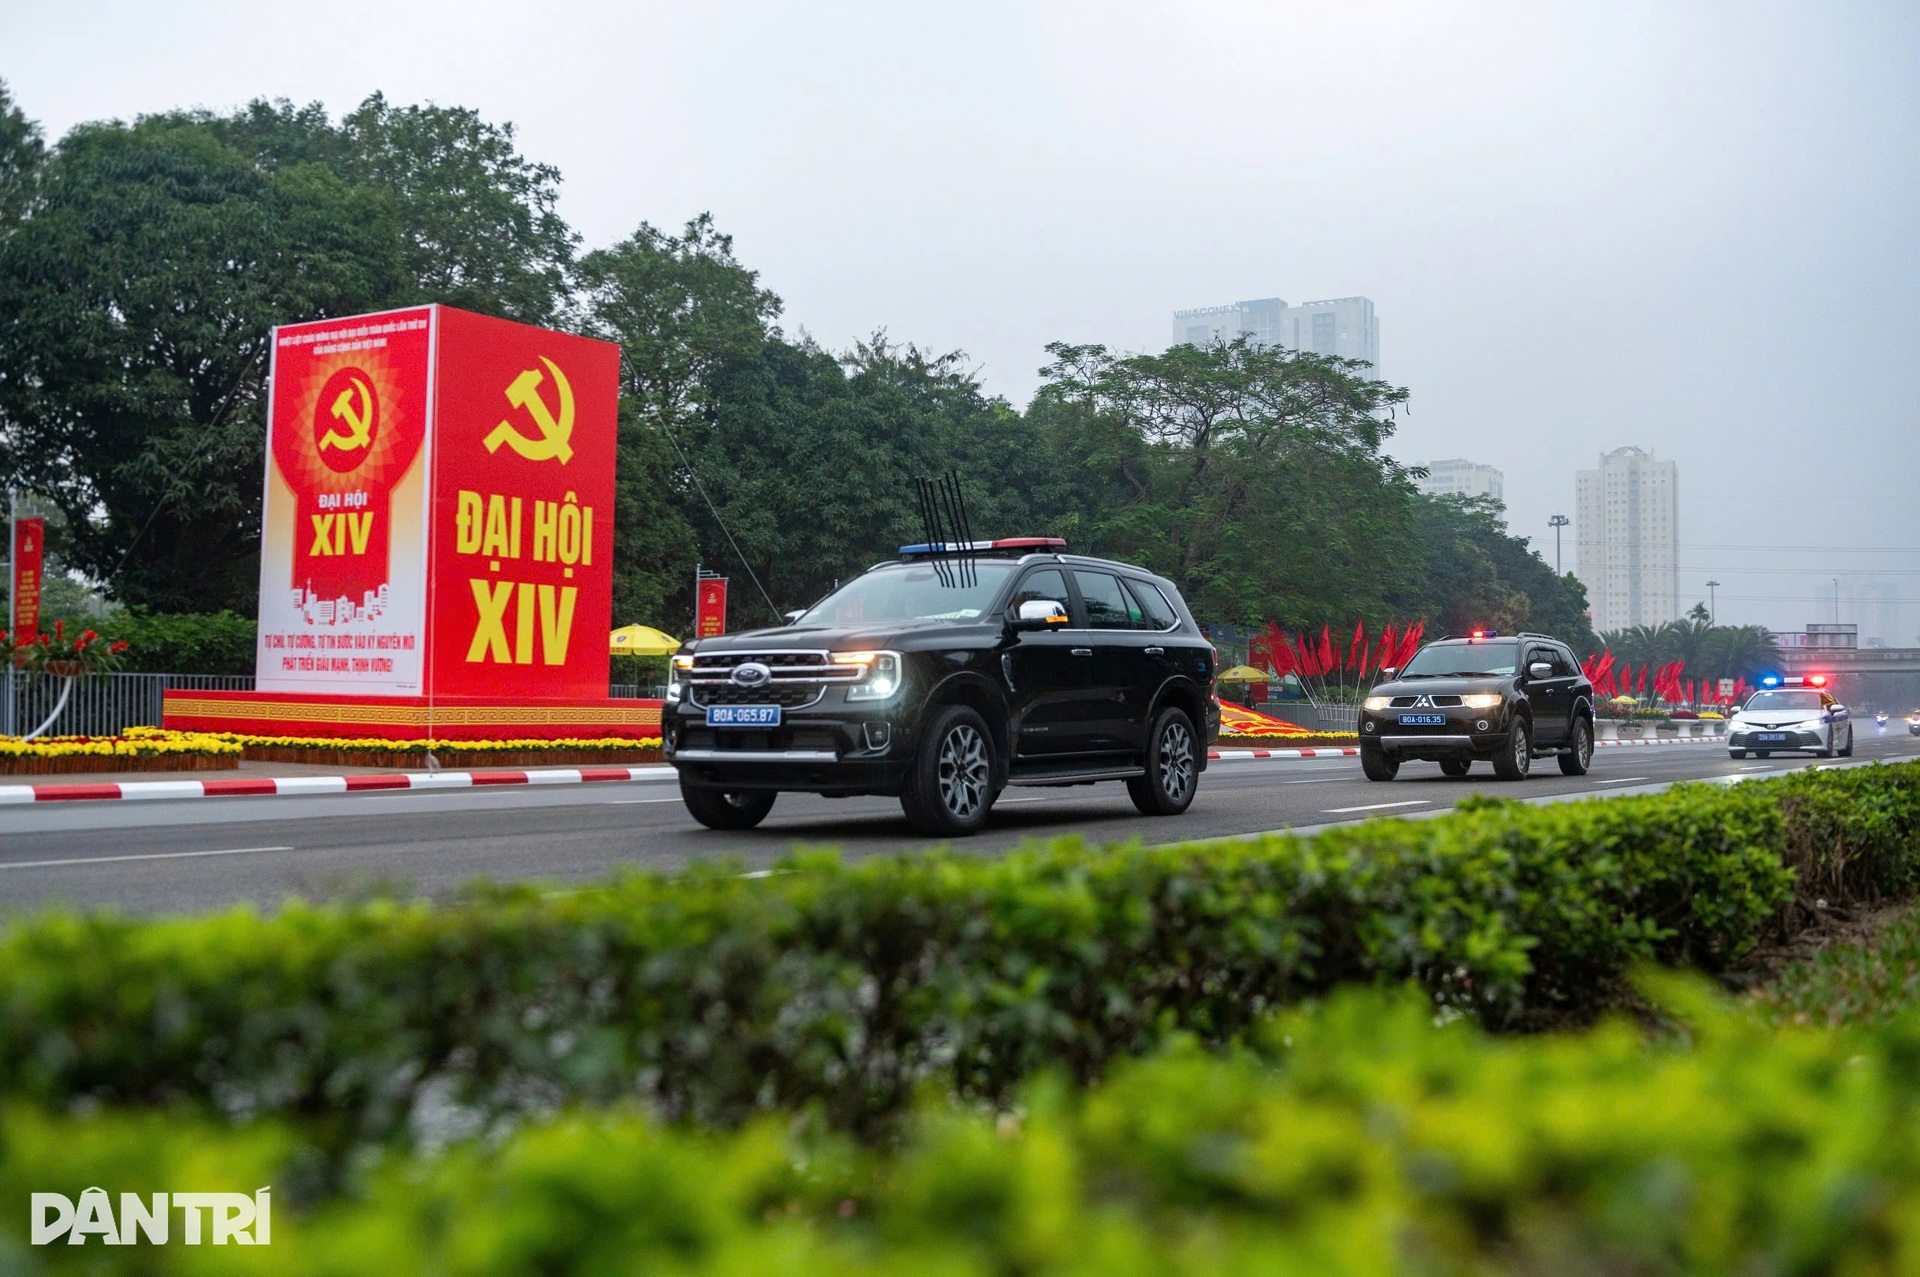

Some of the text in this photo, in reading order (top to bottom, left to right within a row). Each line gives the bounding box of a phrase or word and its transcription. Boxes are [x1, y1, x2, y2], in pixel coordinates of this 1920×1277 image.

[318, 488, 368, 511] ĐẠI HỘI
[308, 511, 374, 556] XIV
[456, 490, 593, 578] ĐẠI HỘI
[465, 578, 578, 666] XIV
[713, 709, 774, 722] 80A-065.87
